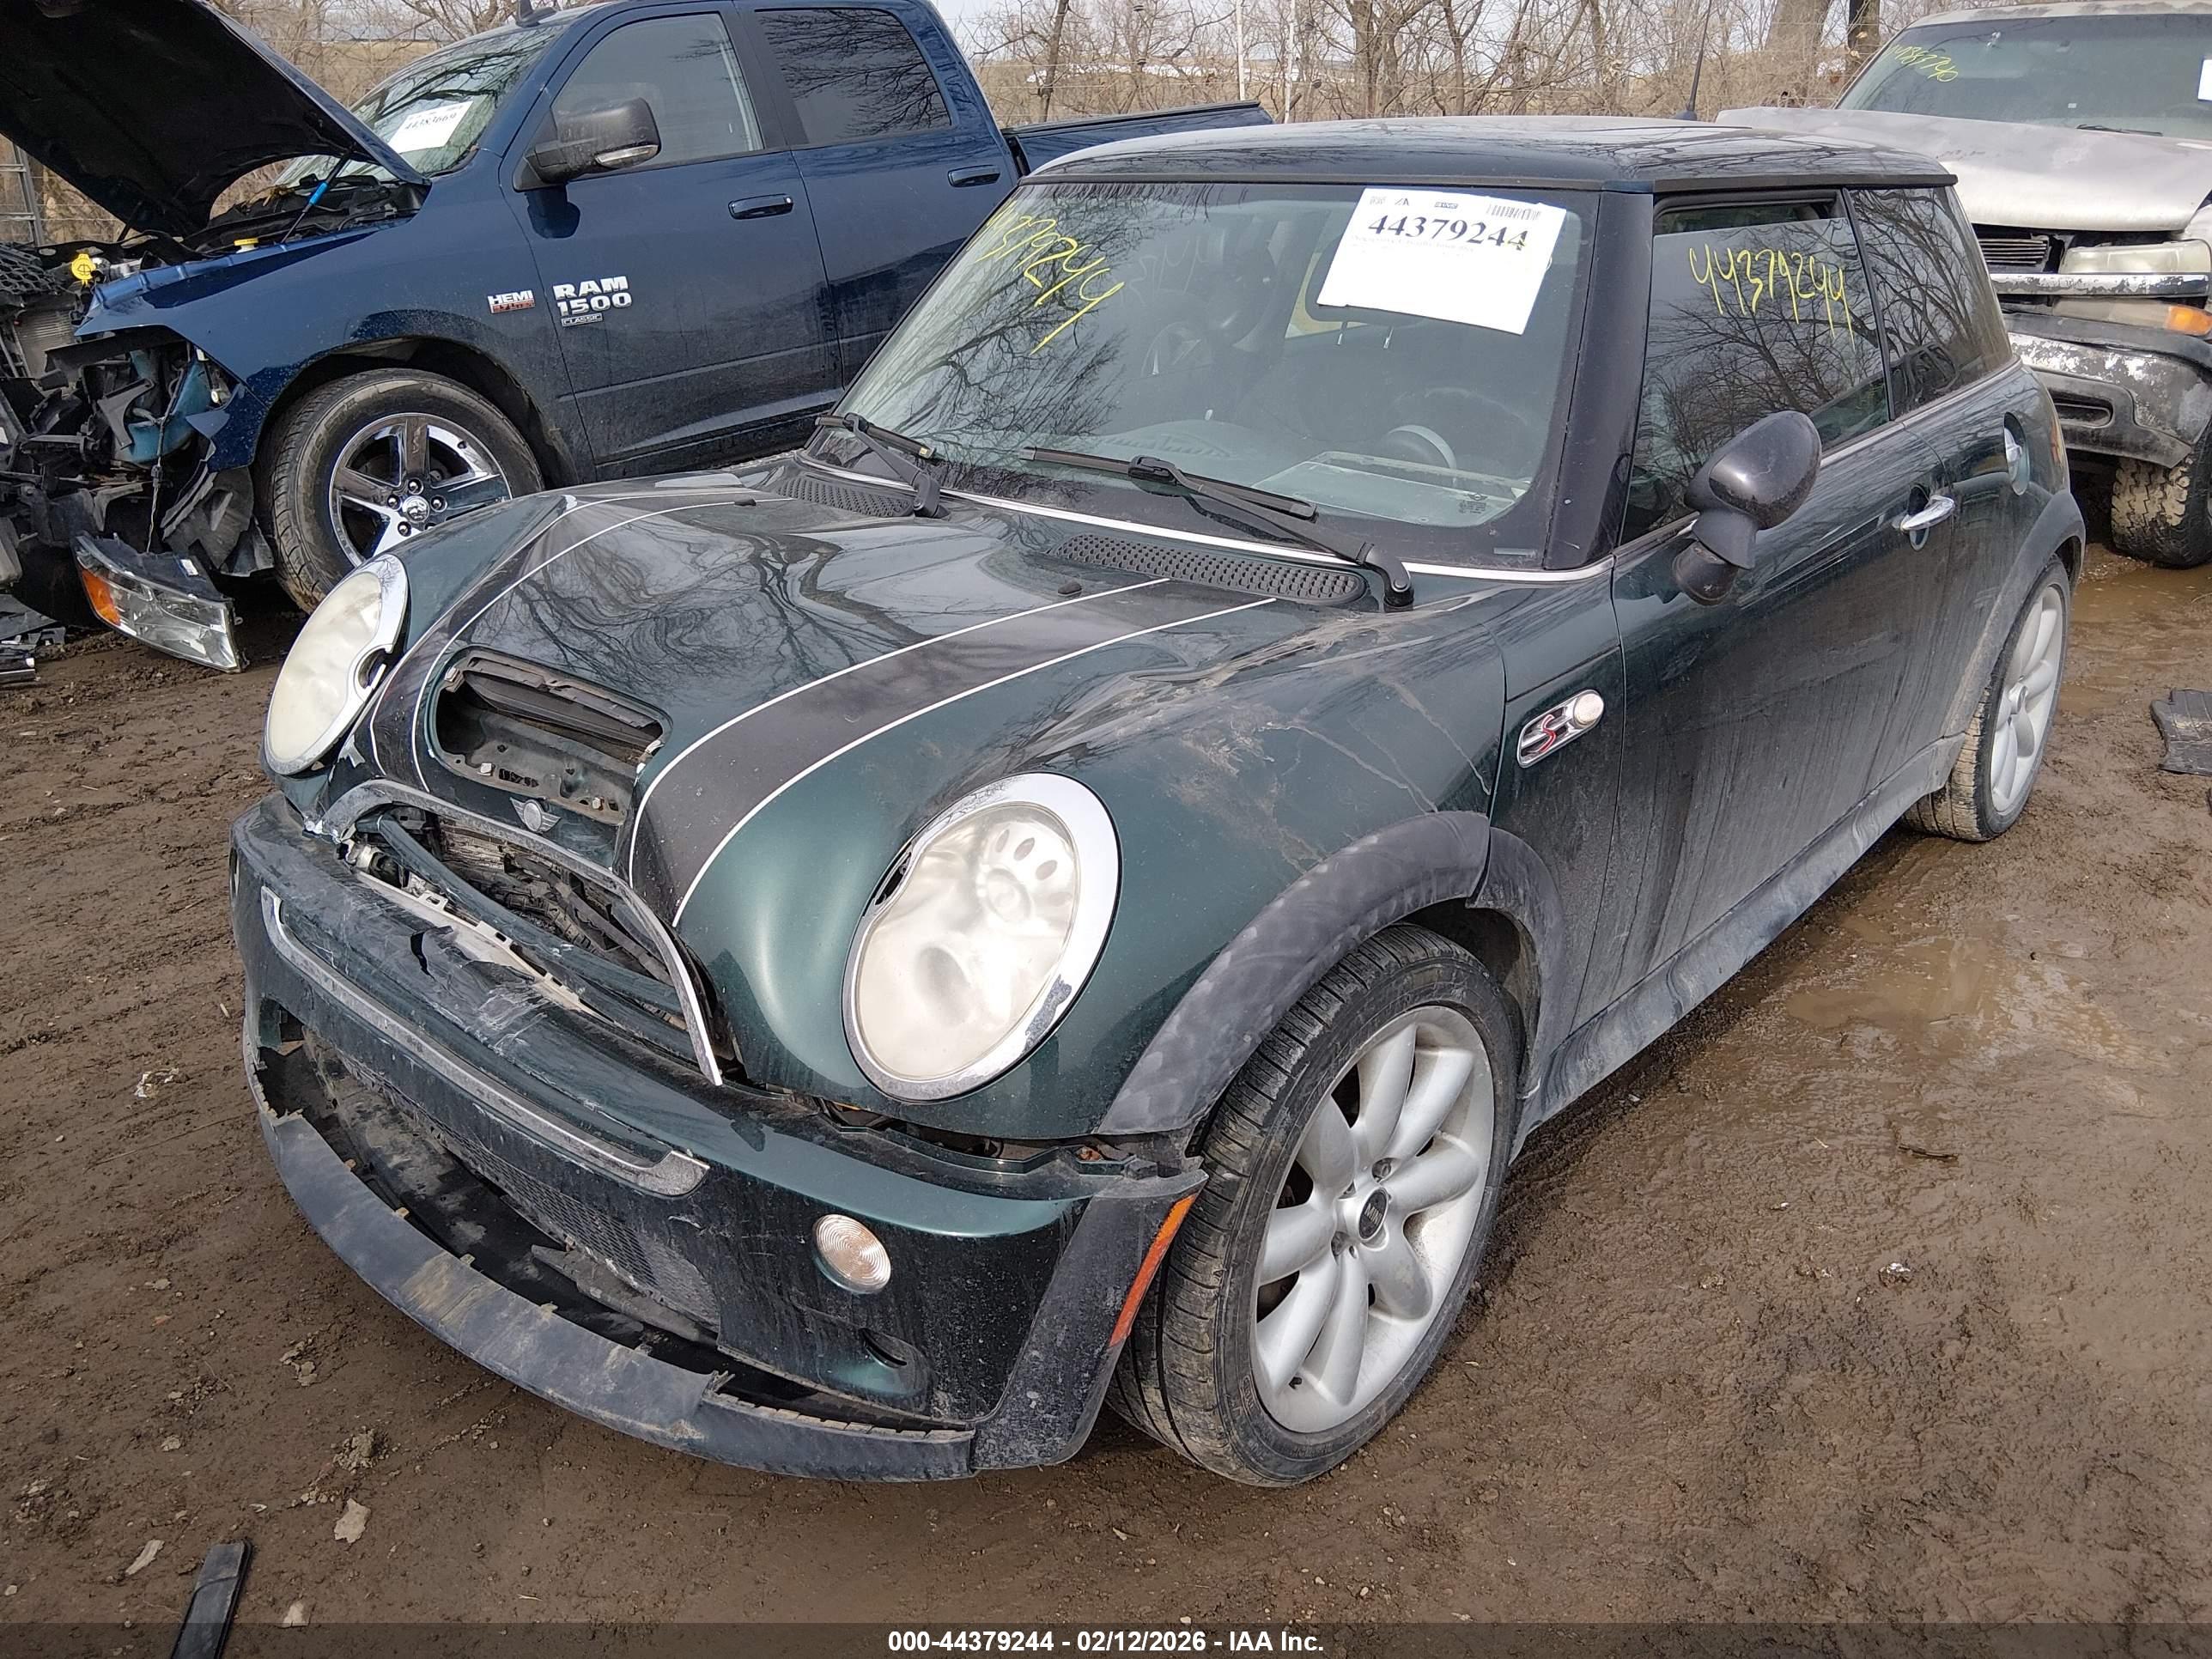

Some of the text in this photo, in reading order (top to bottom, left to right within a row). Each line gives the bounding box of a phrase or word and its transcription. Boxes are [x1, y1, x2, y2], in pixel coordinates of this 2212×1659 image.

[1368, 214, 1528, 251] 44379244
[487, 289, 534, 305] HEMI
[552, 276, 629, 301] RAM
[1688, 243, 1856, 353] 44379244
[556, 292, 632, 317] 1500
[562, 314, 602, 326] CLASSIC
[1537, 714, 1557, 753] S
[1364, 1203, 1383, 1227] MINI
